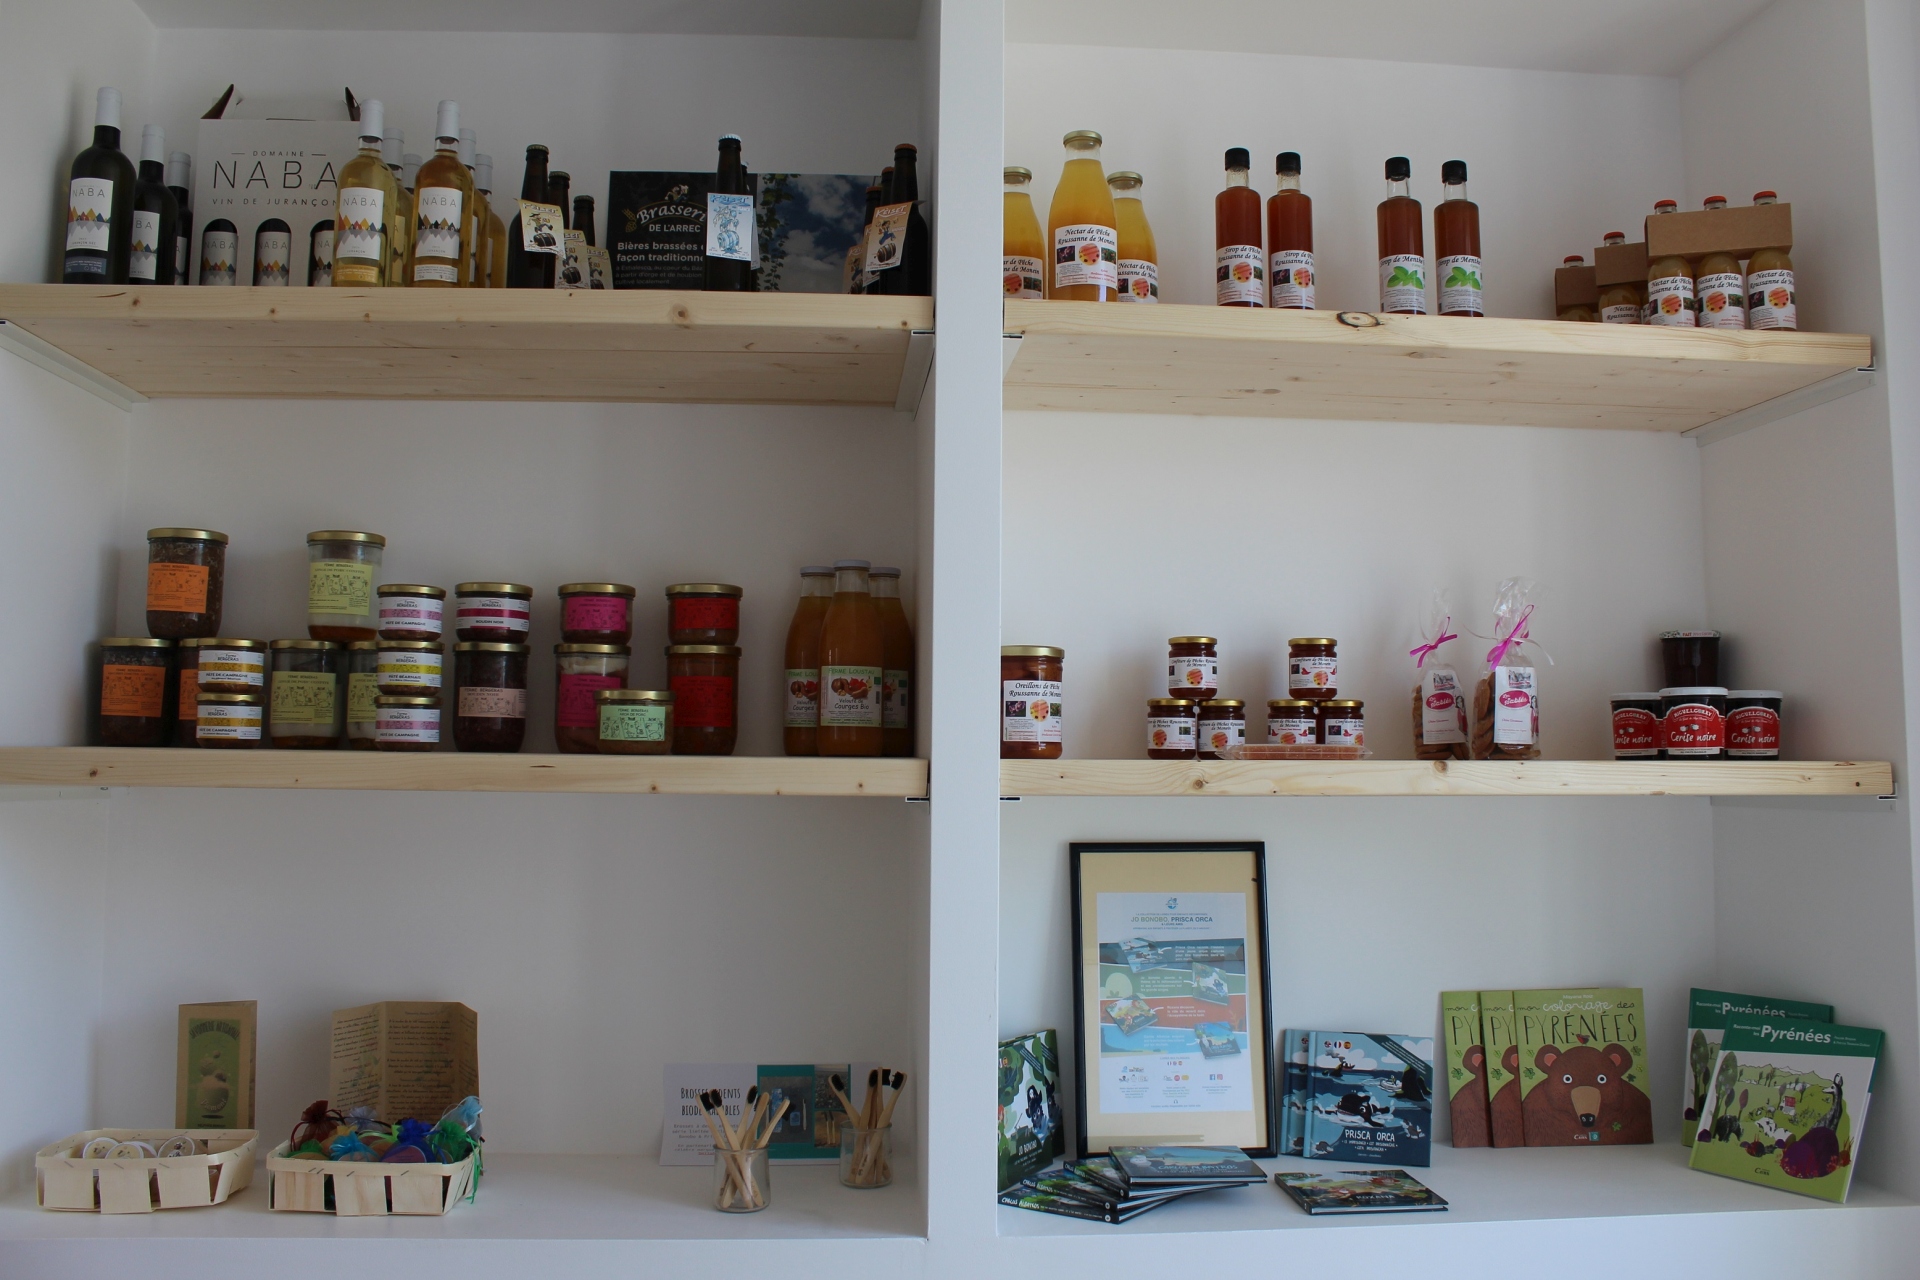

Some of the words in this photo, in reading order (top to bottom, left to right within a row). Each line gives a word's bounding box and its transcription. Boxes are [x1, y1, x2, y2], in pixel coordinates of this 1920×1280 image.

[214, 161, 338, 190] NABA
[72, 187, 105, 198] NABA
[343, 198, 377, 208] NABA
[422, 197, 456, 208] NABA
[636, 205, 706, 224] Brasseri
[135, 220, 152, 230] BA
[1058, 236, 1087, 245] Roussanne
[617, 242, 649, 250] Bières
[652, 242, 698, 250] brassées
[617, 254, 645, 262] façon
[648, 254, 703, 262] traditionn
[1756, 272, 1777, 280] Nectar
[1651, 279, 1669, 288] Nectar
[1614, 305, 1633, 313] Nectar
[1673, 708, 1712, 718] MIGUELGORRY
[1671, 732, 1693, 742] Cerise
[1732, 733, 1757, 743] Cerise
[1543, 1000, 1613, 1013] coloriage
[1722, 1002, 1785, 1018] Pyrénées
[1524, 1012, 1637, 1045] PYRÉNÉES
[1761, 1025, 1831, 1043] Pyrénées
[1345, 1129, 1371, 1140] PRISCA
[1376, 1131, 1395, 1142] ORCA
